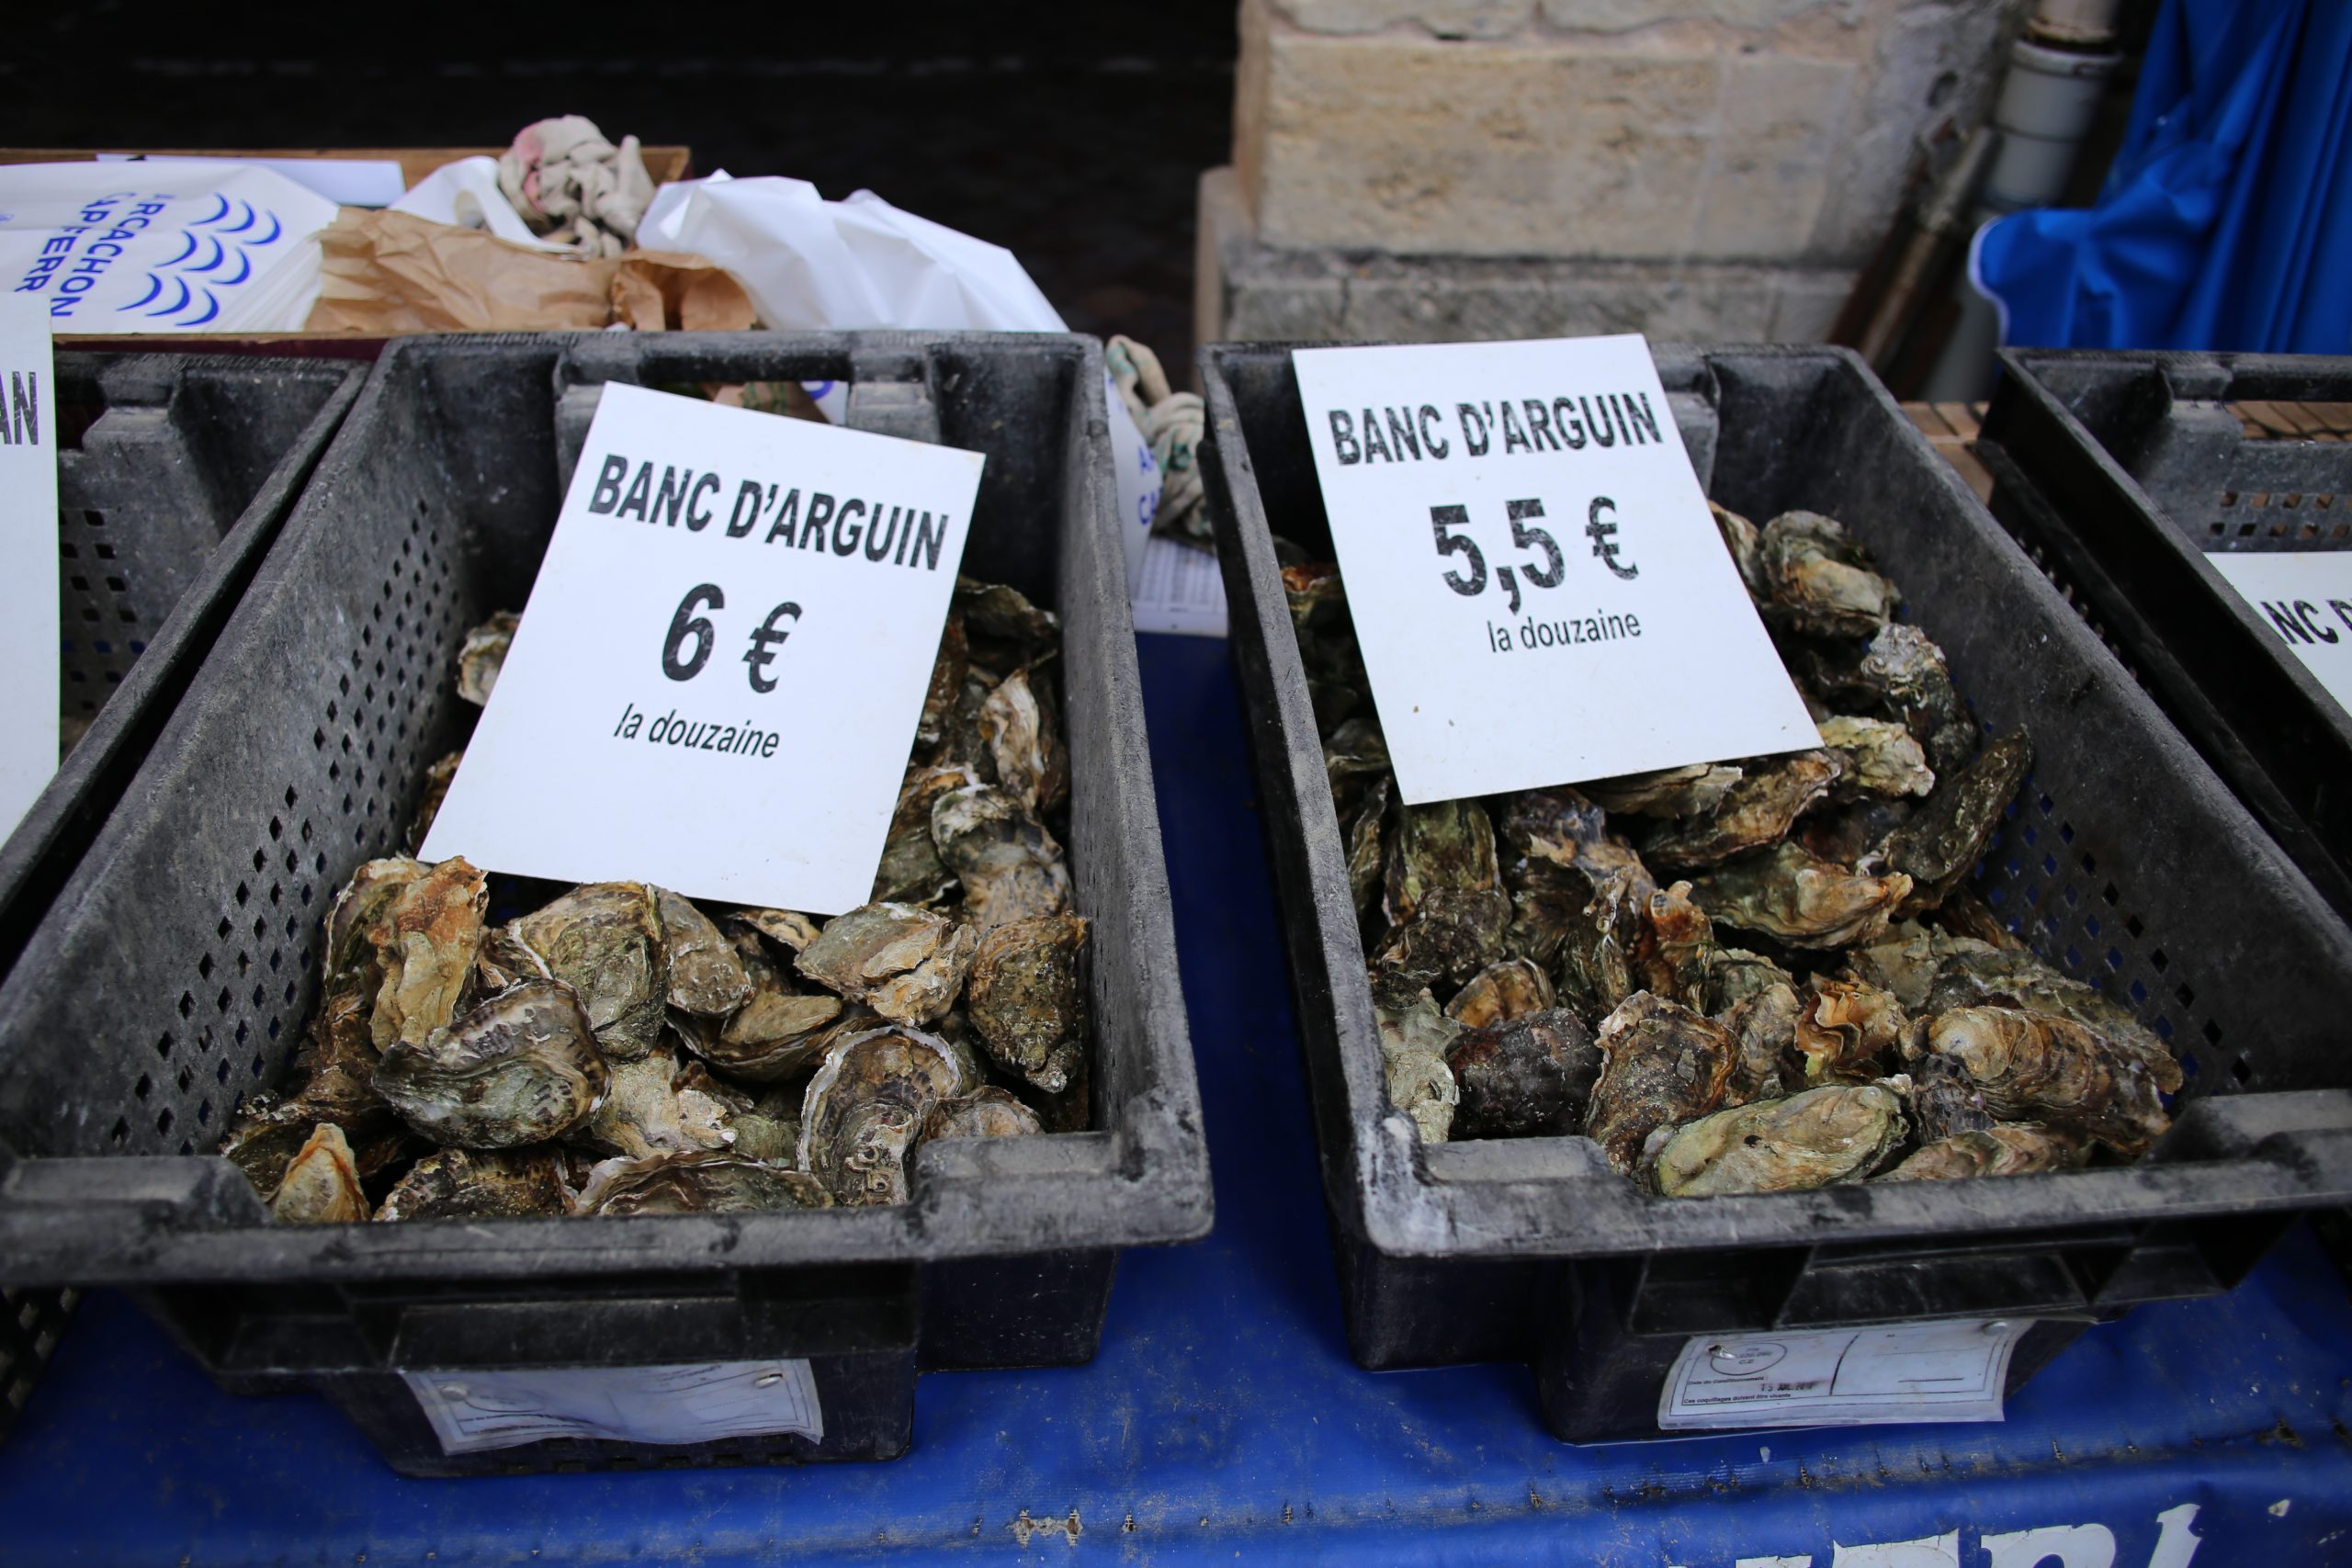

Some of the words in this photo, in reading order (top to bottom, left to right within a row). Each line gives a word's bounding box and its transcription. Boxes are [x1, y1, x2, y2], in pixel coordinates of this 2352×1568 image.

[1328, 404, 1450, 466] BANC
[1455, 391, 1663, 457] D'ARGUIN
[588, 454, 720, 532] BANC
[725, 480, 949, 571] D'ARGUIN
[1430, 498, 1566, 615] 5,5
[1585, 496, 1639, 581] €
[662, 582, 725, 682] 6
[741, 602, 803, 694] €
[1487, 620, 1513, 653] la
[1521, 608, 1642, 650] douzaine
[614, 703, 644, 739] la
[649, 709, 780, 758] douzaine
[1696, 1396, 1732, 1404] coquillages
